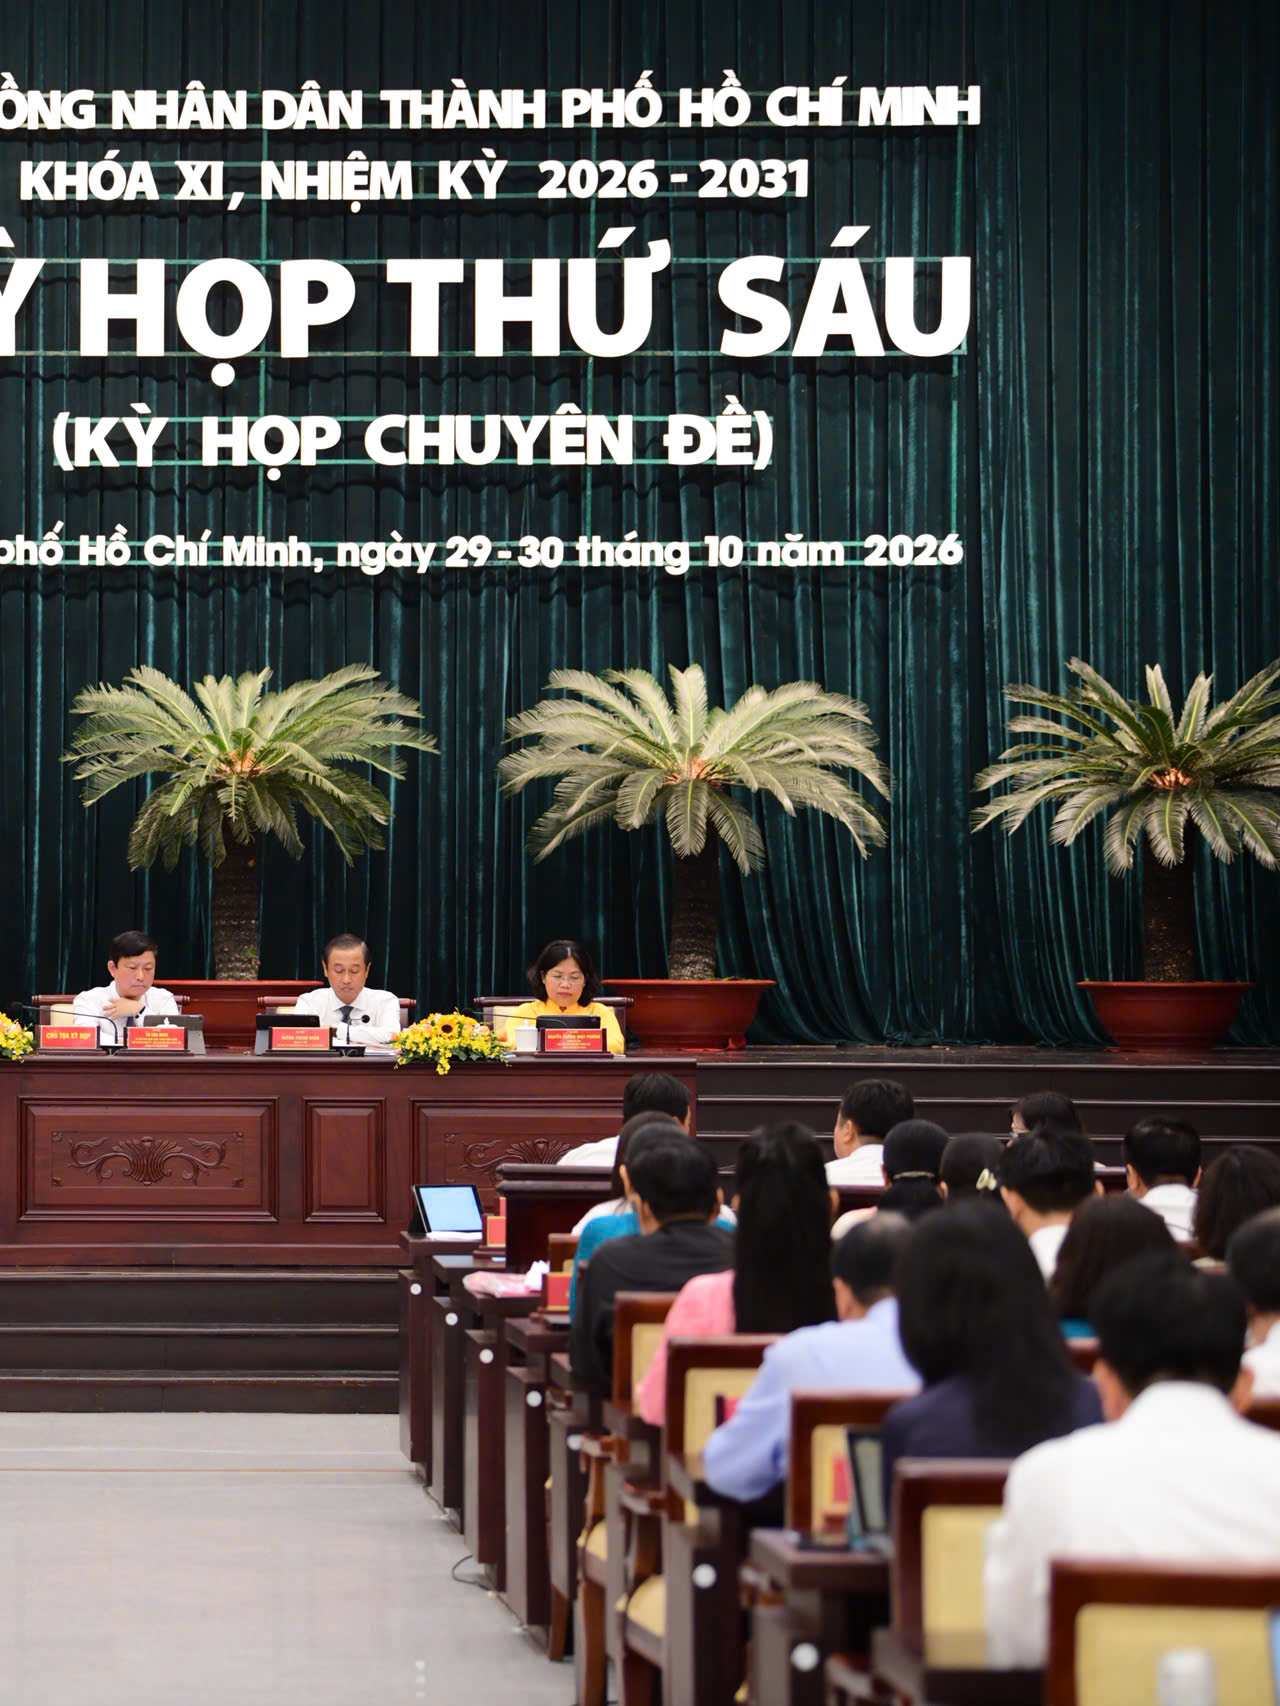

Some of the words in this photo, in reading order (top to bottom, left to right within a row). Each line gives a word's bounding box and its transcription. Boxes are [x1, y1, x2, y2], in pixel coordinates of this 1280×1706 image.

[111, 80, 248, 130] NHÂN
[261, 80, 363, 130] DÂN
[379, 78, 546, 129] THÀNH
[561, 70, 663, 128] PHỐ
[679, 69, 751, 128] HỒ
[766, 76, 848, 127] CHÍ
[857, 85, 981, 127] MINH
[20, 149, 160, 201] KHÓA
[260, 150, 414, 214] NHIỆM
[438, 147, 508, 200] KỲ
[79, 257, 356, 387] HỌP
[386, 226, 671, 358] THỨ
[718, 225, 971, 358] SÁU
[53, 402, 170, 471] (KỲ
[201, 414, 342, 481] HỌP
[364, 402, 634, 466] CHUYÊN
[663, 394, 773, 470] ĐỀ)
[78, 523, 131, 566] Hồ
[143, 528, 212, 567] Chí
[222, 535, 324, 573] Minh,
[336, 530, 437, 576] ngày
[575, 530, 691, 576] tháng
[704, 535, 744, 568] 10
[756, 533, 845, 567] năm
[863, 533, 964, 567] 2026
